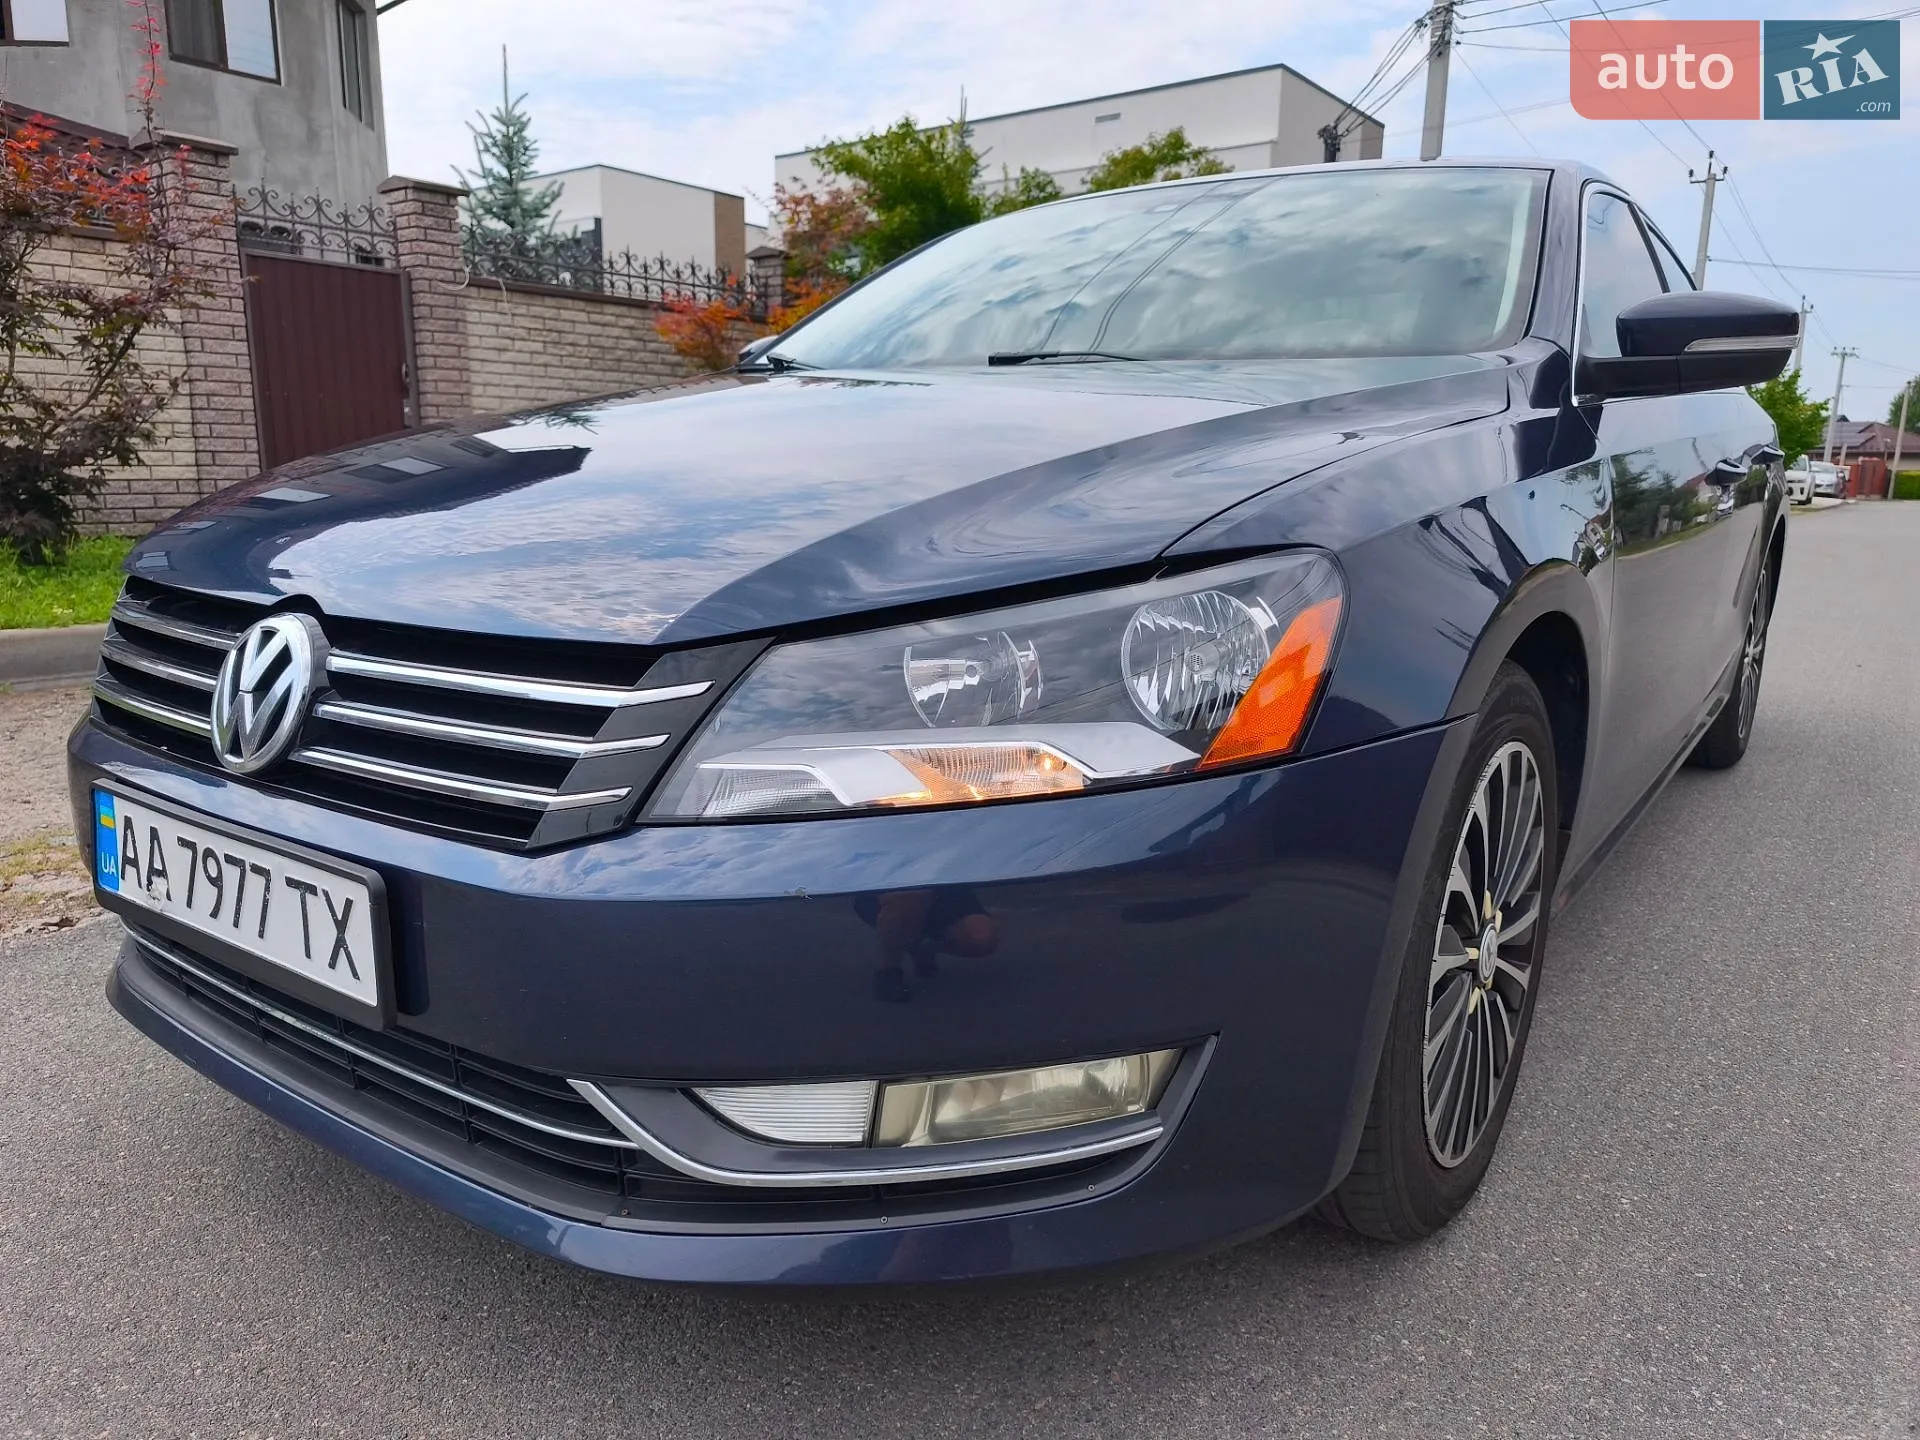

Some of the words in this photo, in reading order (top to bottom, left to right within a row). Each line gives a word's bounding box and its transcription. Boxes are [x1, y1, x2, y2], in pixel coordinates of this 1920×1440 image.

[101, 853, 117, 877] UA
[120, 815, 172, 902] AA
[176, 835, 272, 939] 7977
[284, 875, 361, 981] TX
